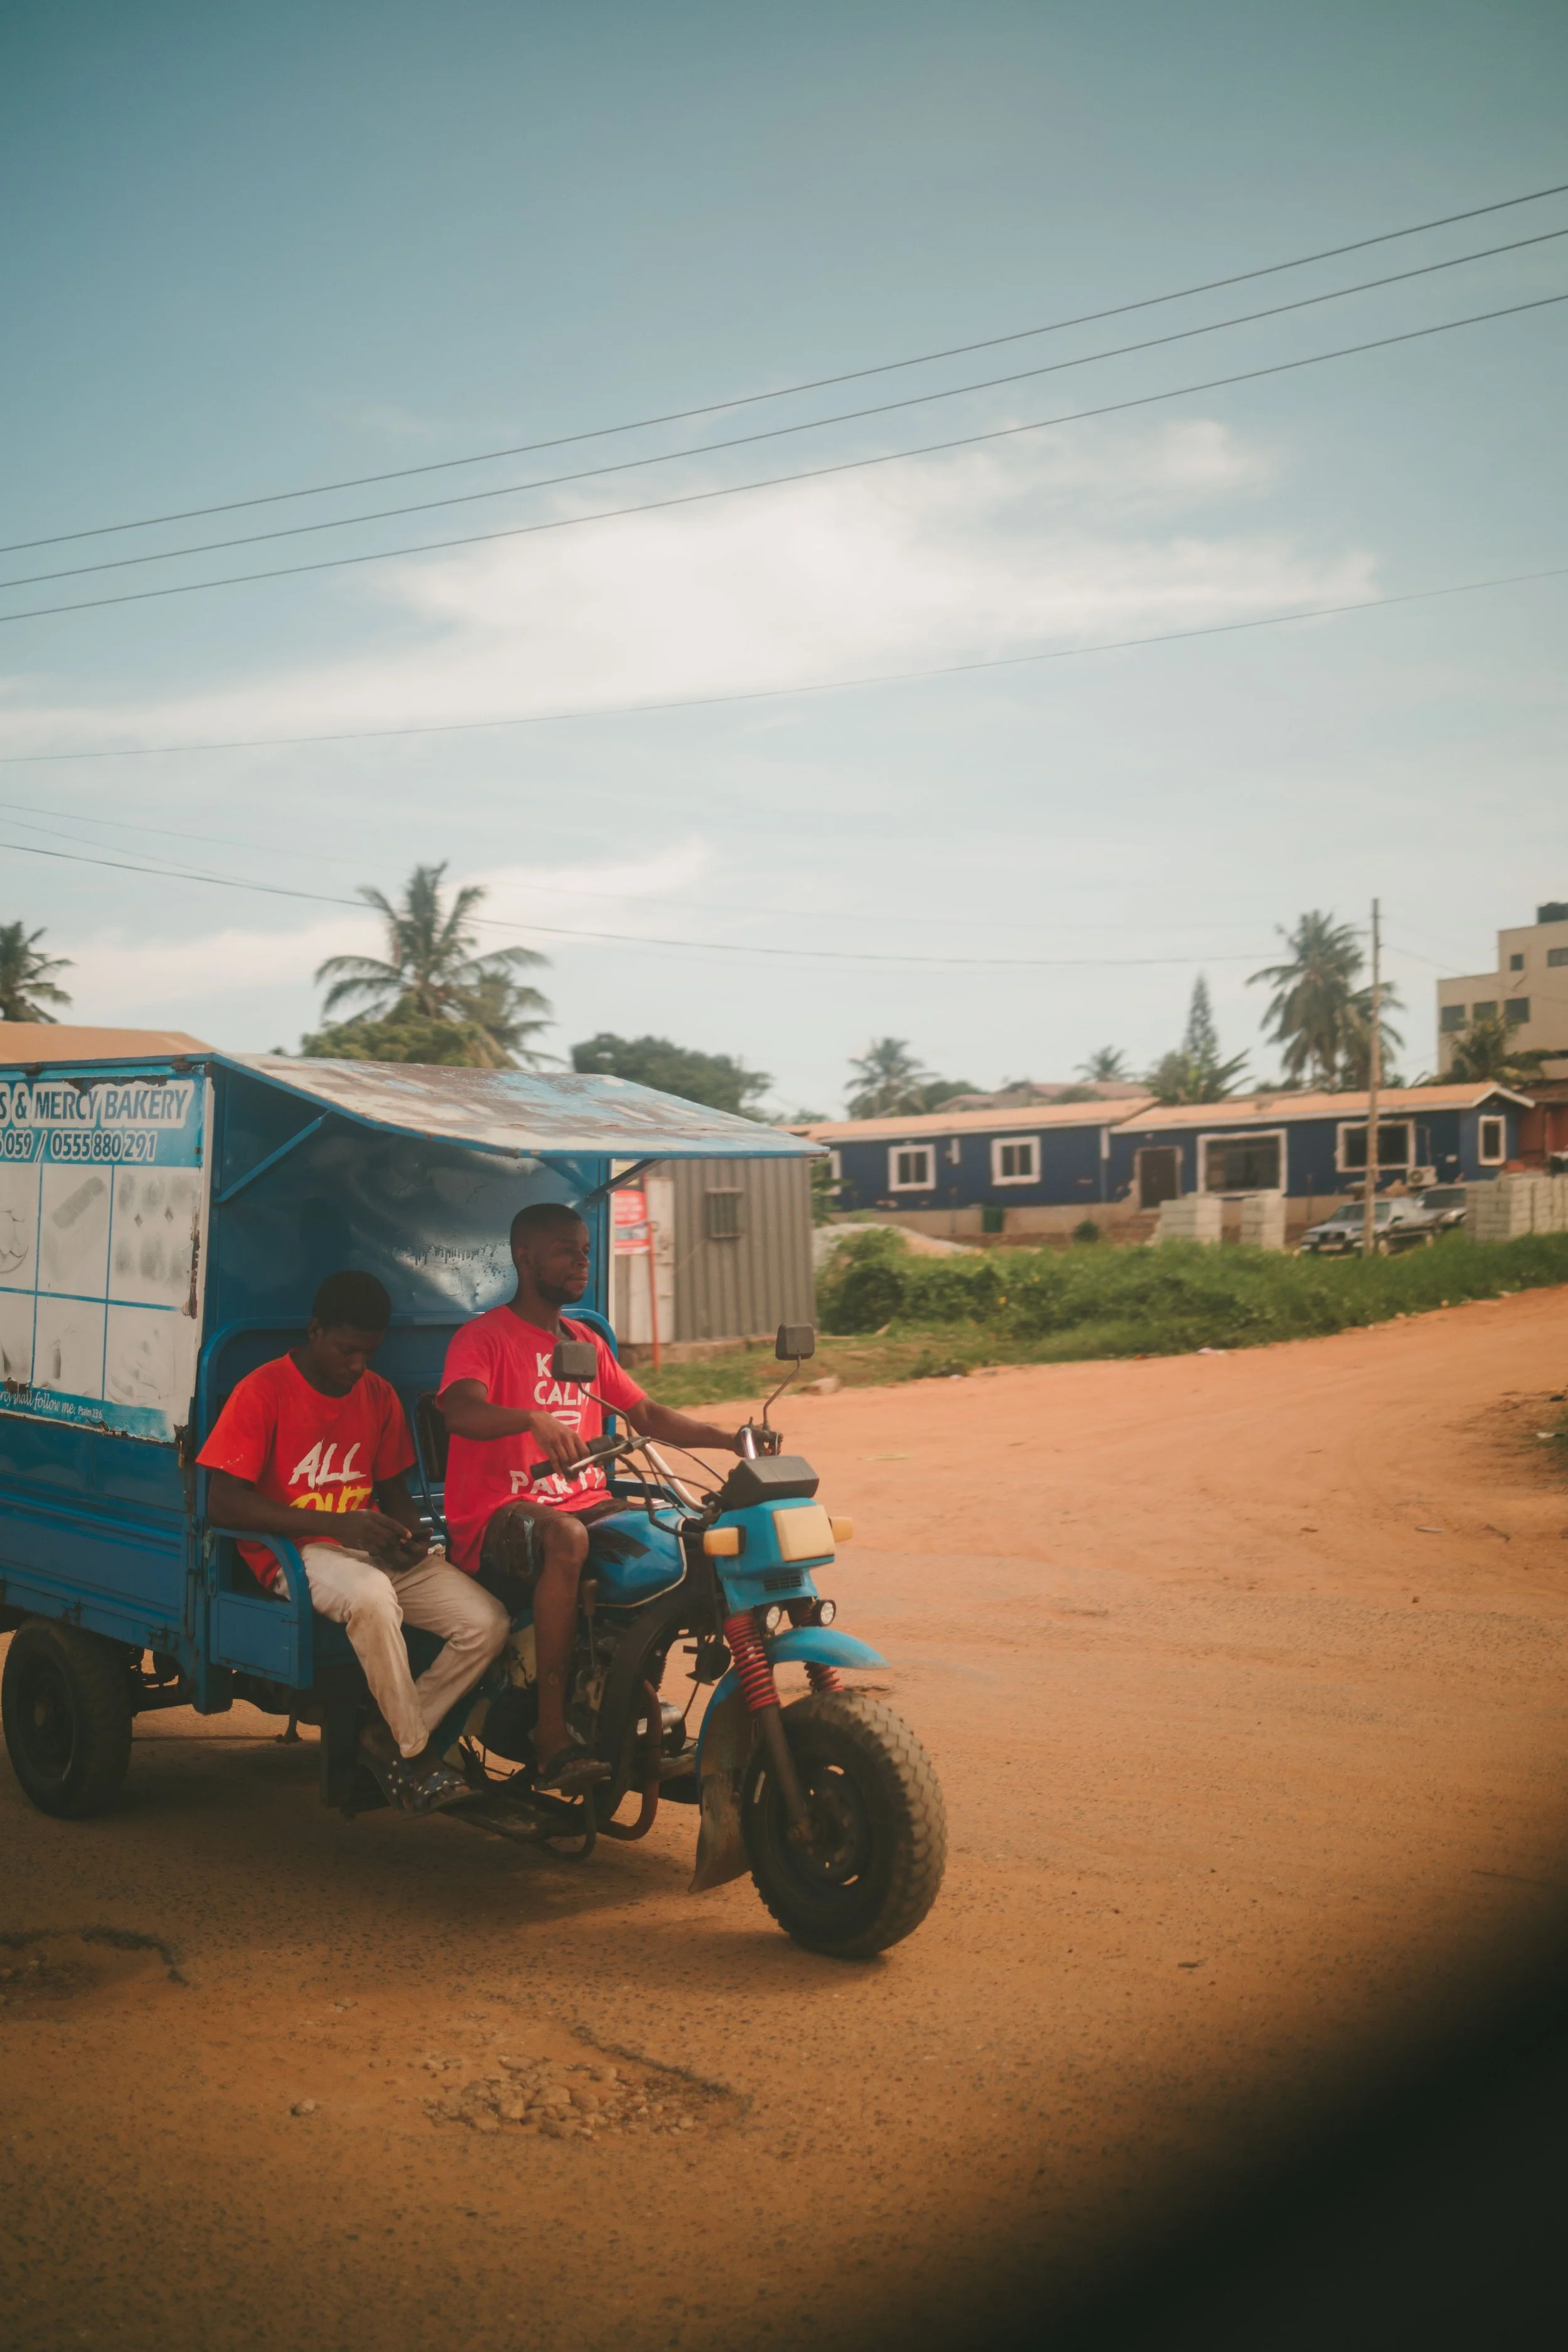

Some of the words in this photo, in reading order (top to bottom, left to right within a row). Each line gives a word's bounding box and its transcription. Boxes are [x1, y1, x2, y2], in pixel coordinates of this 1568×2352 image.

[15, 1091, 27, 1120] &
[34, 1091, 98, 1120] MERCY
[104, 1089, 188, 1120] BAKERY
[13, 1389, 34, 1406] shall
[34, 1391, 61, 1411] follow
[78, 1406, 92, 1416] Psalm
[534, 1380, 591, 1406] CALM
[288, 1438, 366, 1489] ALL
[509, 1467, 606, 1495] PARTY
